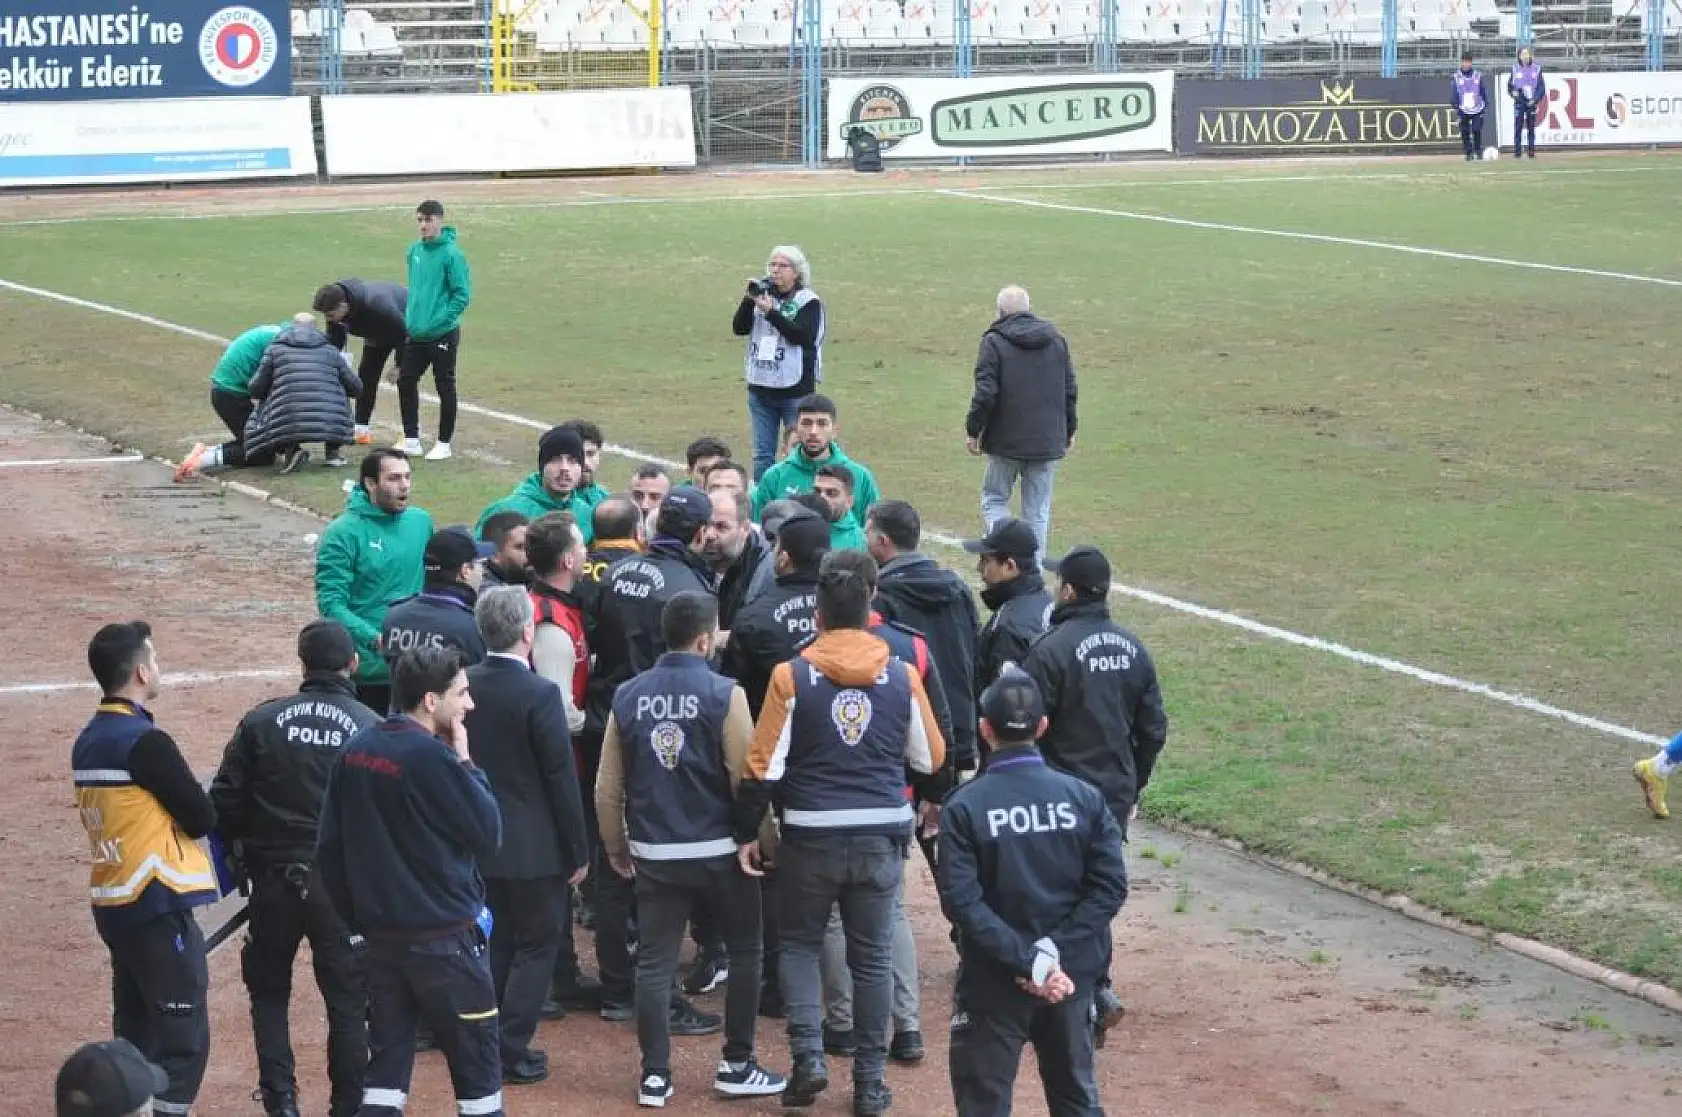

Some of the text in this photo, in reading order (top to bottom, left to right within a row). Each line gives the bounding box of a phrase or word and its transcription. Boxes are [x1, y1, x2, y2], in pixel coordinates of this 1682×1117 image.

[81, 55, 163, 86] Ederiz
[948, 93, 1142, 132] MANCERO
[1358, 108, 1461, 141] HOME
